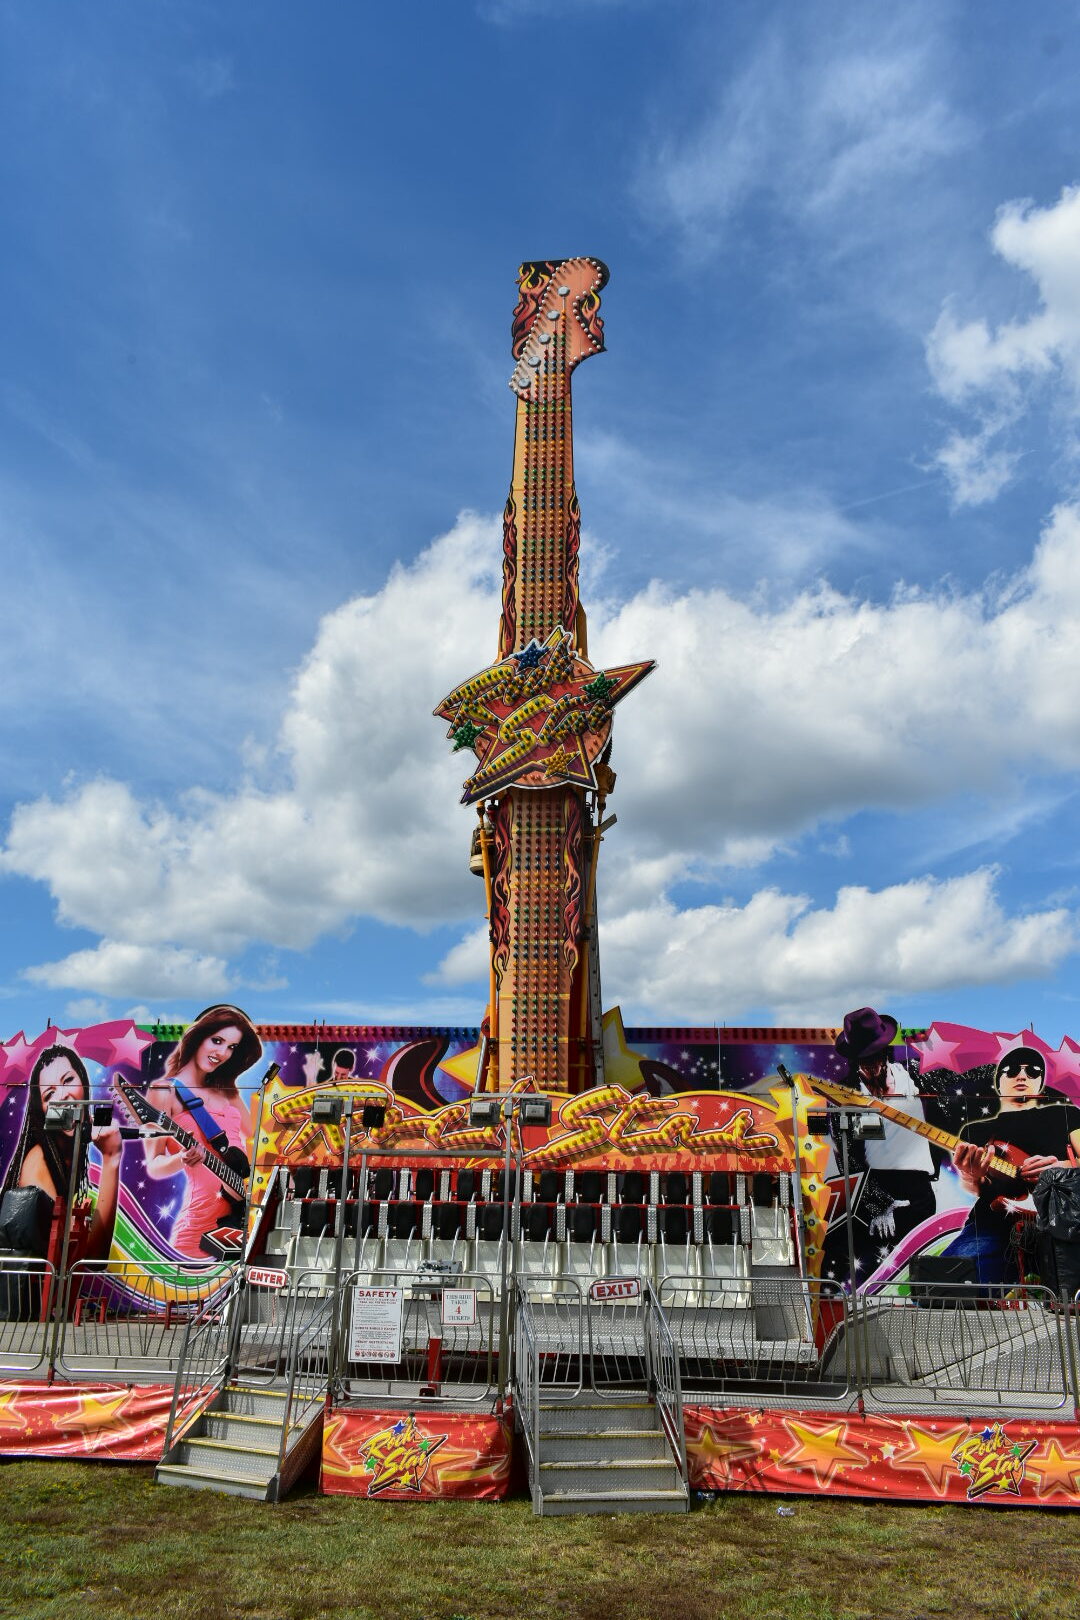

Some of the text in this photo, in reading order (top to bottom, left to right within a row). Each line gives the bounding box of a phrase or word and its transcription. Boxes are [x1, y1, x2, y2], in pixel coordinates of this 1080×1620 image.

[433, 633, 577, 739] Rock
[463, 694, 613, 788] Star
[272, 1076, 778, 1165] Rock Star
[250, 1271, 283, 1285] ENTER
[359, 1290, 397, 1298] SAFETY
[596, 1283, 633, 1297] EXIT
[454, 1305, 462, 1314] 4
[359, 1420, 416, 1460] Rock
[953, 1427, 1004, 1465] Rock
[370, 1447, 429, 1486] Star
[968, 1452, 1023, 1491] Star
